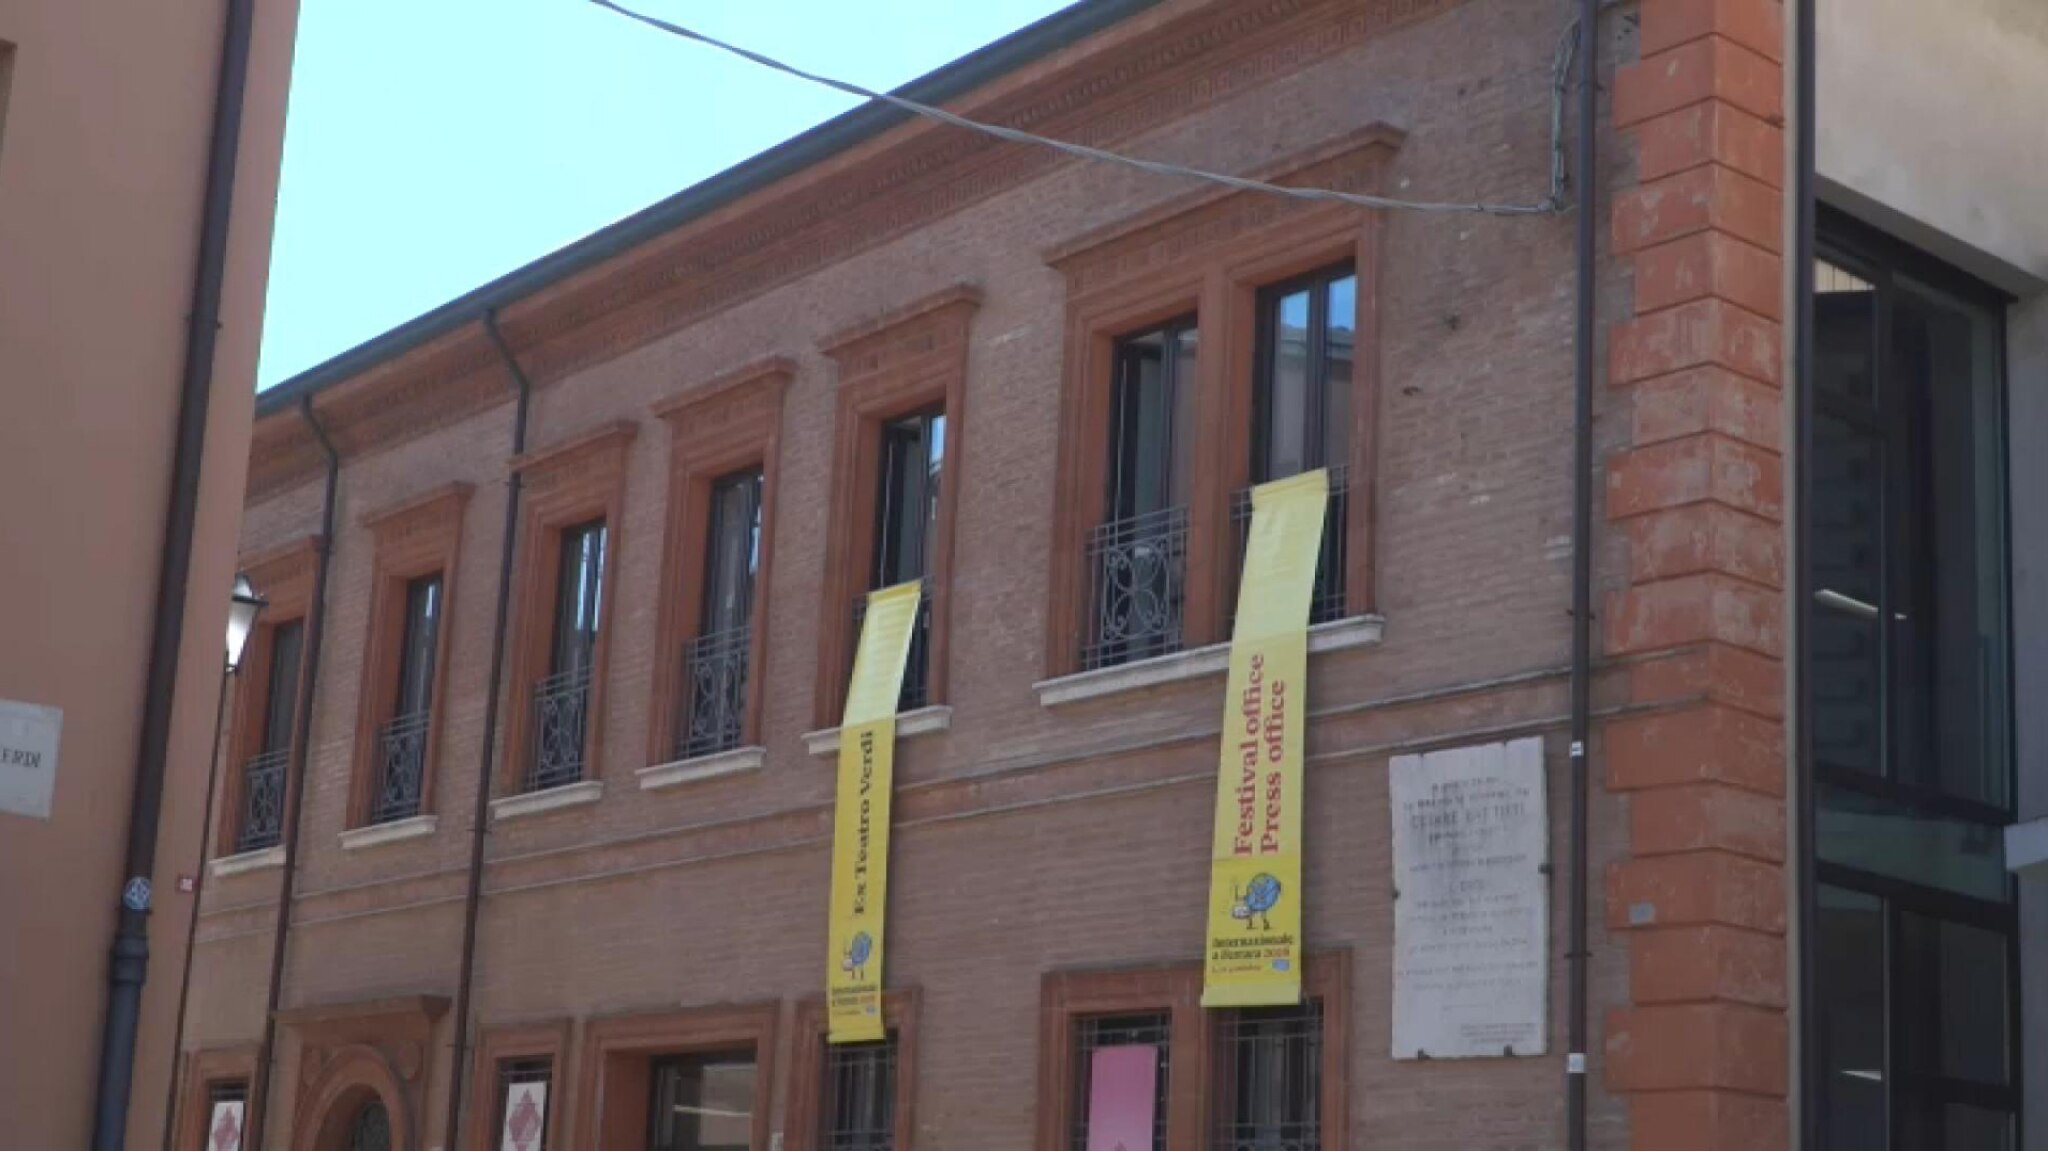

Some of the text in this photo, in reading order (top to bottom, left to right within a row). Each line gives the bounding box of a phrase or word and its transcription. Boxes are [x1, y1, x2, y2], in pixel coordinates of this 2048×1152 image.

[0, 747, 41, 768] ERDI
[854, 730, 873, 914] Ex Teatro Verdi
[1234, 654, 1264, 855] Festival office
[1260, 680, 1285, 853] Press office
